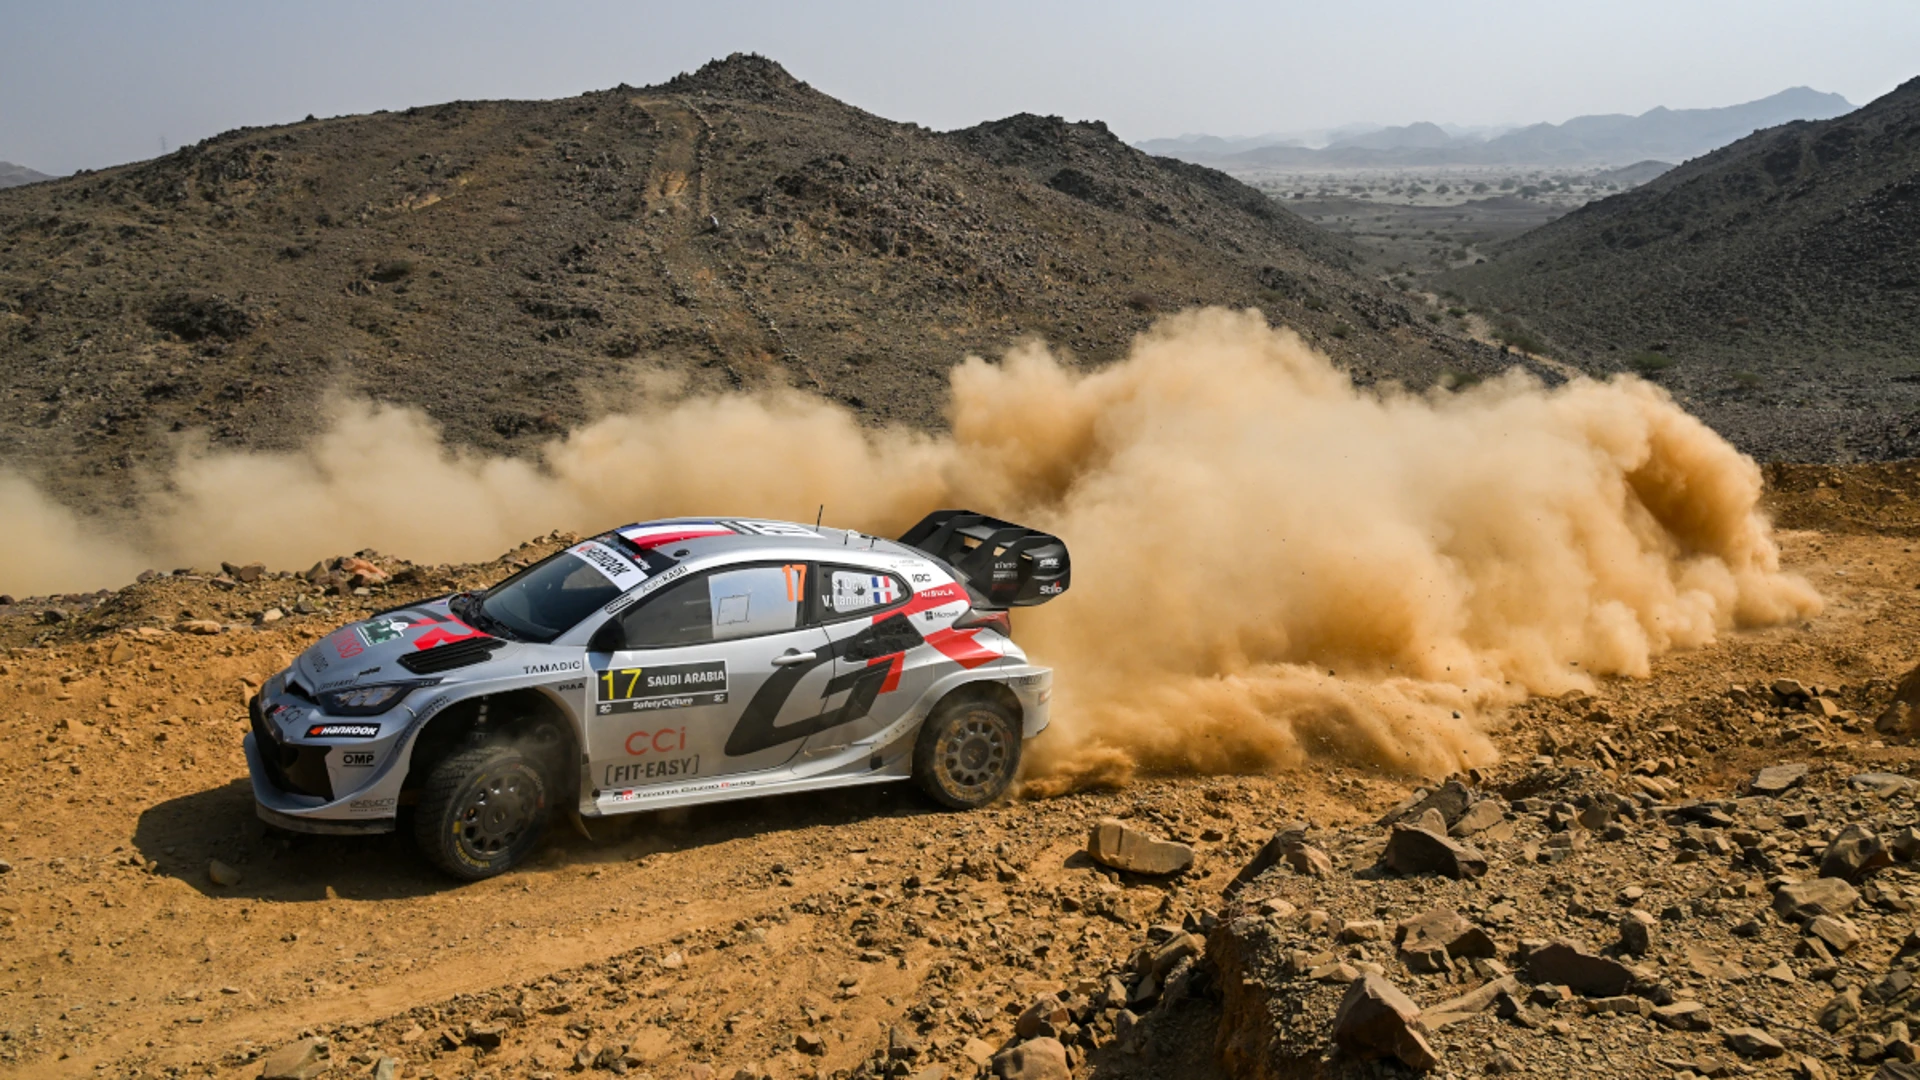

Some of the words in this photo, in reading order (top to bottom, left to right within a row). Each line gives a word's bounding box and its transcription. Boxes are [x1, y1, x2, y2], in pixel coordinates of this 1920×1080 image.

[782, 564, 807, 602] 17
[523, 660, 581, 674] TAMADIC
[558, 682, 585, 691] PIAA
[601, 668, 642, 700] 17
[647, 674, 681, 687] SAUDI
[684, 670, 725, 684] ARABIA
[632, 697, 693, 709] SafetyCulture
[343, 754, 375, 764] OMP
